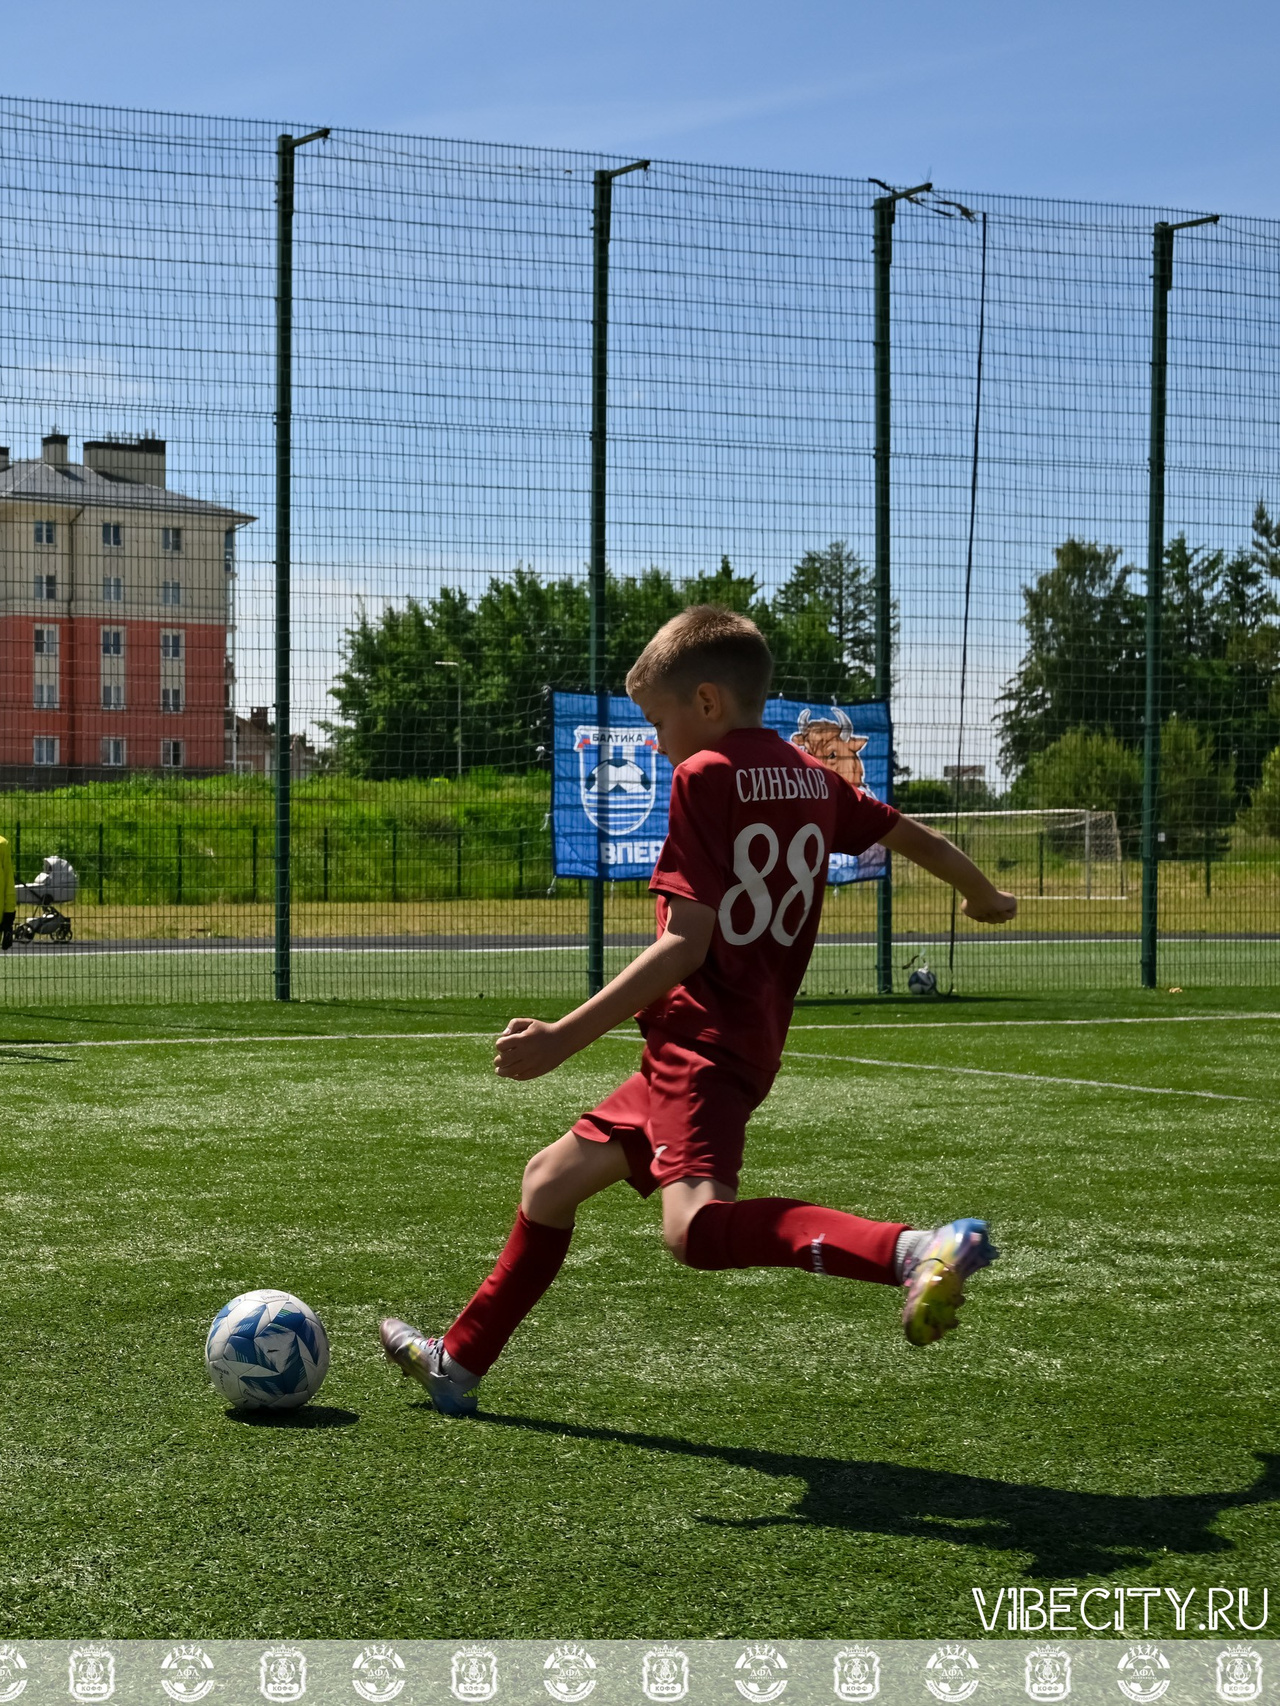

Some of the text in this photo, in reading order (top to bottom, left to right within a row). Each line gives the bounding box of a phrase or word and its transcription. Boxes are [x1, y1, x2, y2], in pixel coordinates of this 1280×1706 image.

[592, 733, 643, 743] БАЛТИКА
[736, 767, 829, 803] СИНЬКОВ
[718, 823, 825, 946] 88
